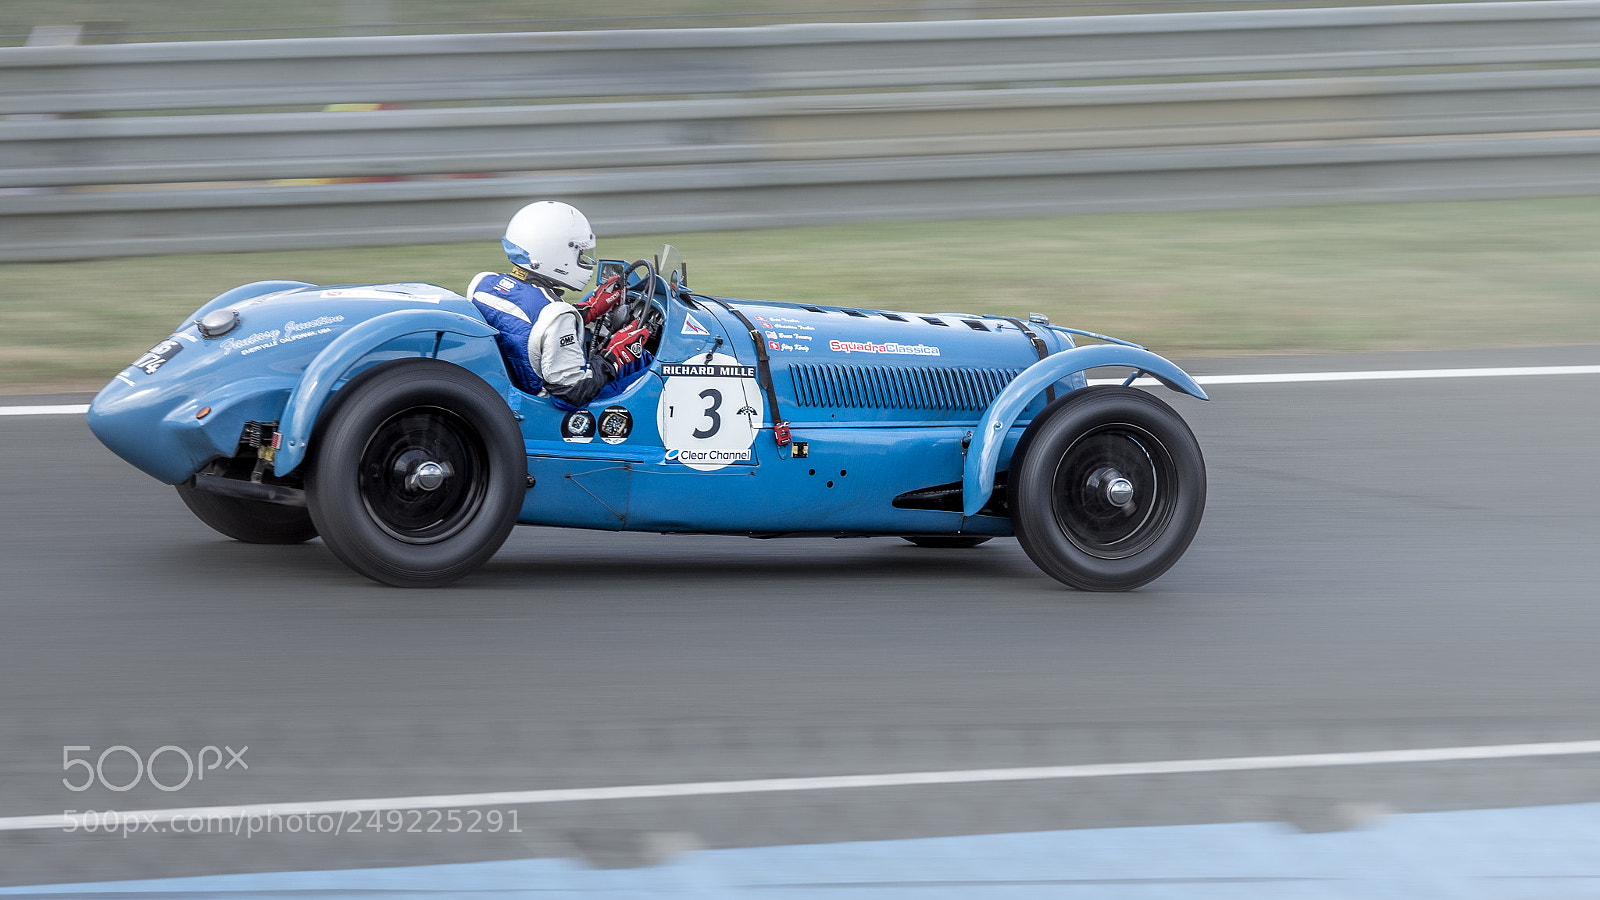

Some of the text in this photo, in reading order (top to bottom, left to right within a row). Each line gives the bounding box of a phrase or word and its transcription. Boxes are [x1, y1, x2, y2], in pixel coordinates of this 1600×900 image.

[560, 335, 575, 346] OMP
[830, 339, 940, 356] SquadraClassica
[662, 366, 755, 377] RICHARD MILLE
[669, 406, 674, 418] 1
[692, 388, 723, 439] 3
[680, 451, 750, 461] Clear Channel
